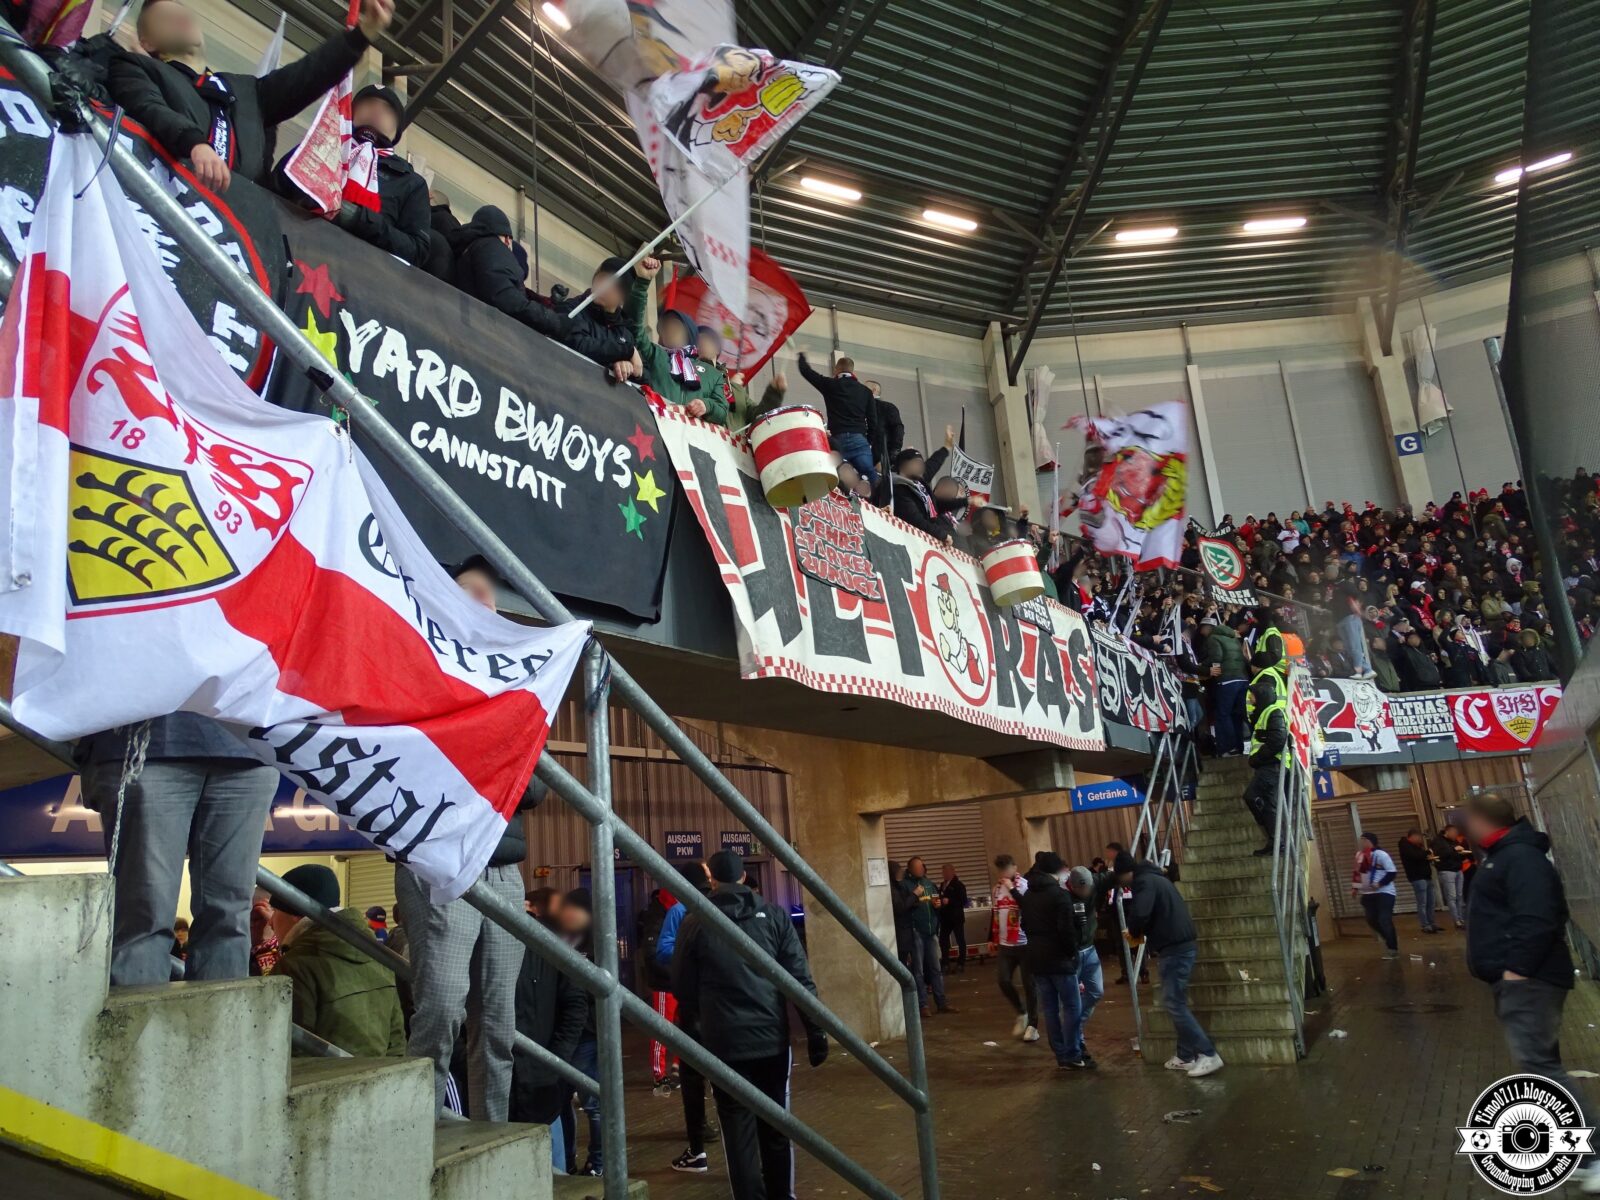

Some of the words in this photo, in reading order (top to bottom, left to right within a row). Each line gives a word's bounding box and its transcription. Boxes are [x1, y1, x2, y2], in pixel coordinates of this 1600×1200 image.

[339, 308, 482, 418] YARD
[495, 386, 632, 488] BWOYS
[109, 419, 146, 450] 18
[1401, 436, 1418, 452] G
[410, 421, 566, 509] CANNSTATT
[213, 500, 243, 534] 93
[1229, 588, 1251, 598] DEN
[1391, 699, 1449, 716] ULTRAS
[1329, 754, 1337, 766] F
[1087, 788, 1128, 802] Getränke
[667, 834, 701, 844] AUSGANG
[722, 835, 750, 844] AUSGANG
[676, 846, 694, 856] PKW
